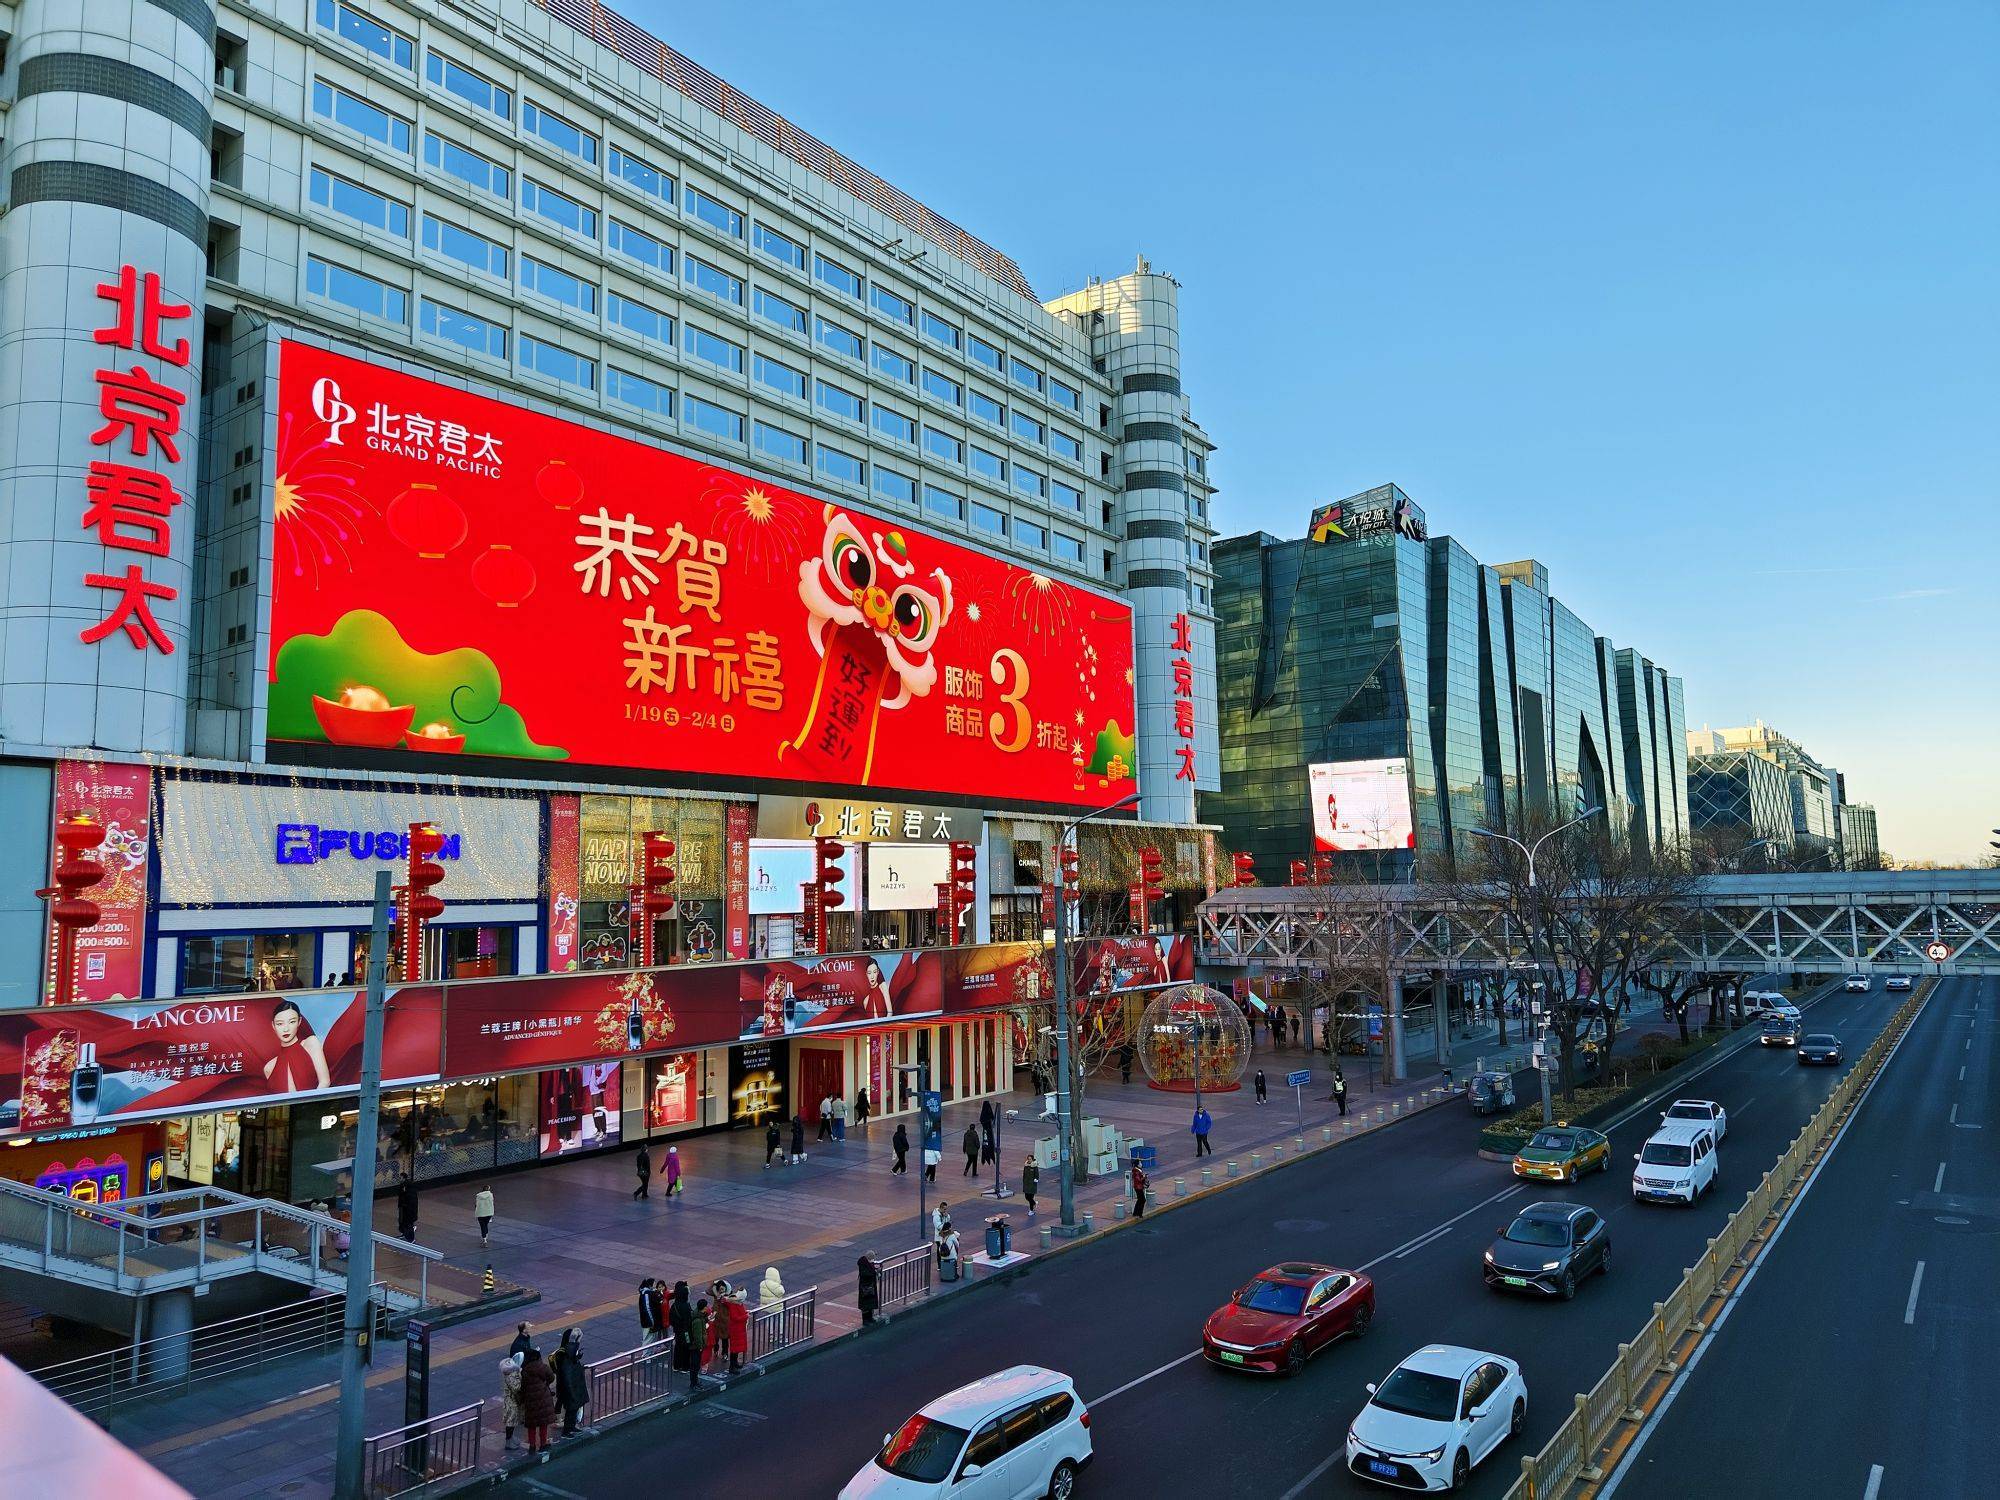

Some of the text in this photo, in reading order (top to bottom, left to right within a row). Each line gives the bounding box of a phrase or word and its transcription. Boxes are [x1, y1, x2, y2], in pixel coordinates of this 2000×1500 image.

[366, 401, 503, 465] 北京君太
[78, 264, 192, 656] 北京君太
[366, 435, 501, 480] GRAND PACIFIC
[573, 506, 728, 623] 恭賀
[622, 605, 785, 711] 新禧
[945, 665, 983, 701] 服饰
[989, 648, 1068, 753] 3 折起
[1171, 612, 1196, 782] 北京君太
[945, 704, 983, 738] 商品
[837, 805, 952, 840] 北京君太
[320, 829, 461, 861] FUSIN
[807, 959, 856, 975] LANCÔME
[132, 1004, 246, 1030] LANCÔME
[503, 1031, 533, 1041] ADVANCED
[130, 1051, 244, 1069] HAPPY NEW YEAR
